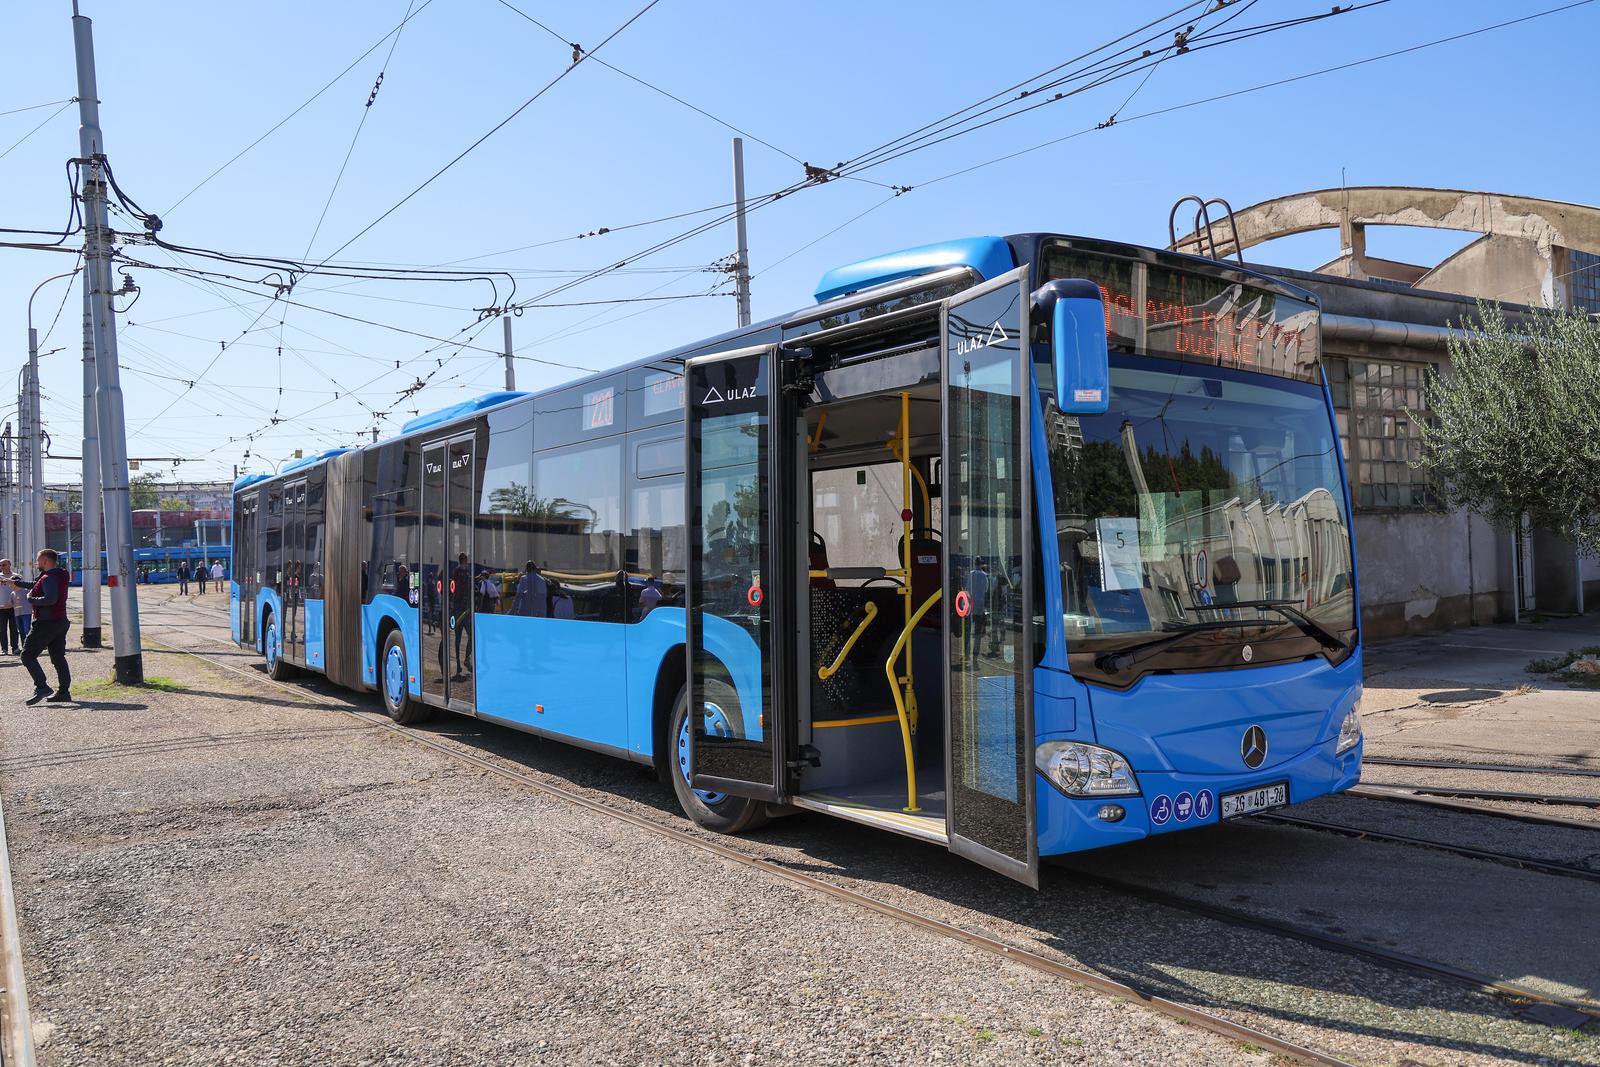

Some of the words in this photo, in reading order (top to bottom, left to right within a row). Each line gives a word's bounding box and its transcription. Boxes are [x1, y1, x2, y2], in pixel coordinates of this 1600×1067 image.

[957, 334, 983, 355] ULAZ
[727, 386, 757, 401] ULAZ
[1116, 531, 1125, 549] 5
